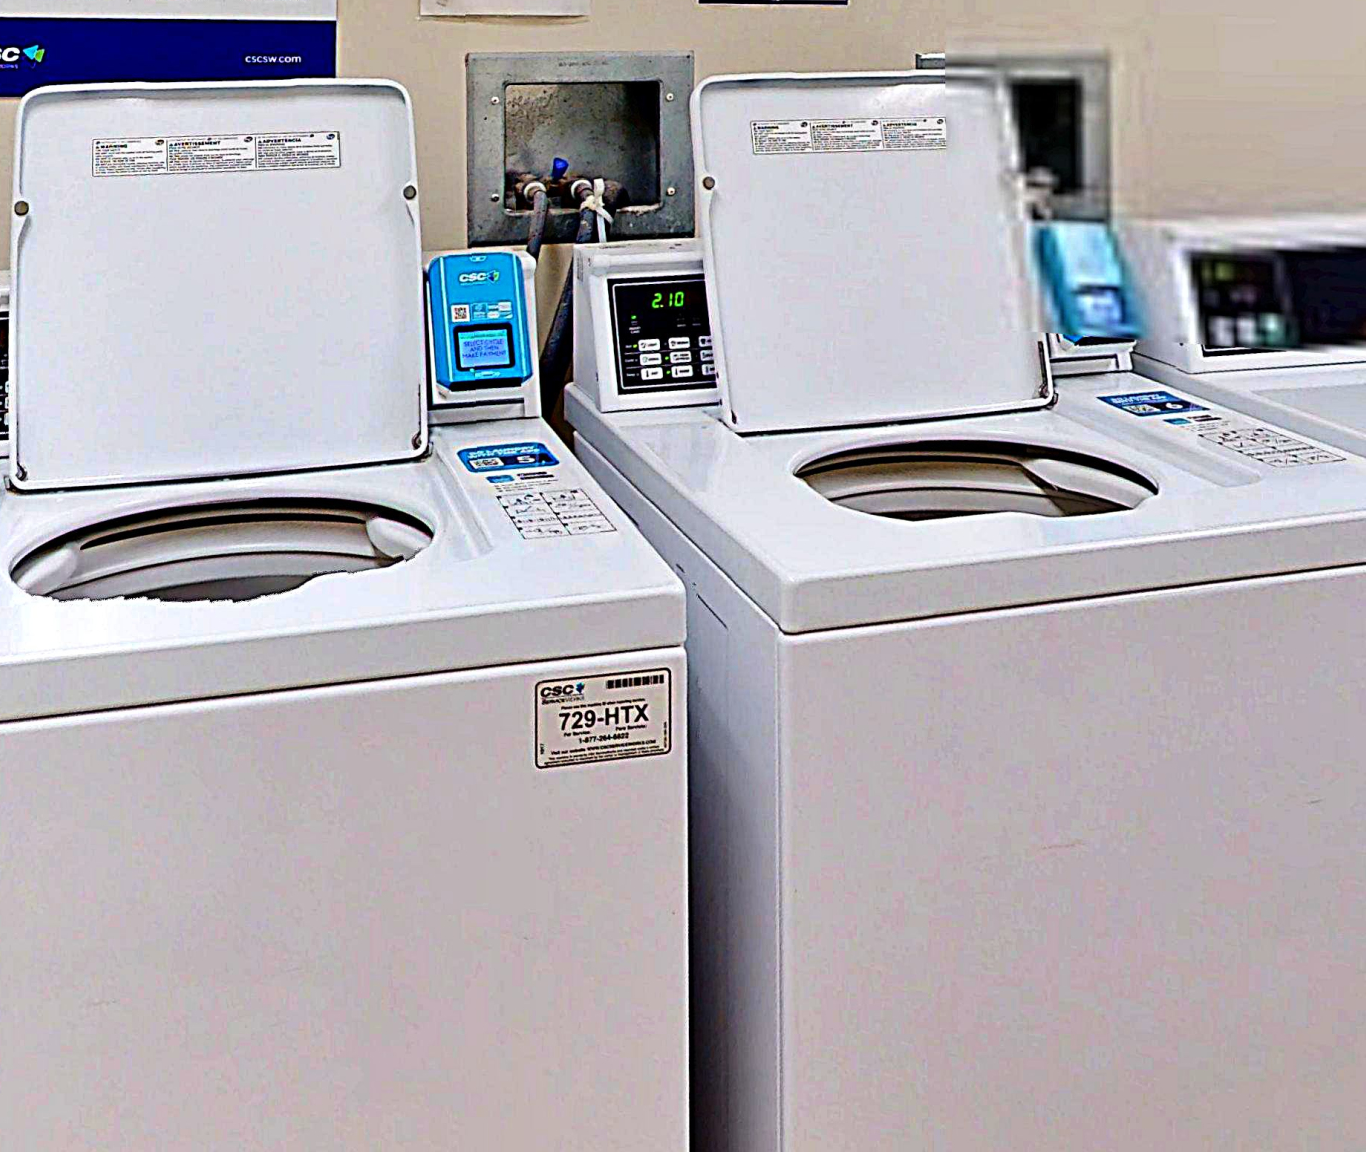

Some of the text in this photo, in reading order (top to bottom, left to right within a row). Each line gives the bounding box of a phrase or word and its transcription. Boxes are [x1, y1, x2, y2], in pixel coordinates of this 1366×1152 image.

[459, 273, 486, 282] CSC
[652, 292, 684, 308] 2.10
[541, 685, 574, 697] CSC
[559, 704, 649, 730] 729-HTX
